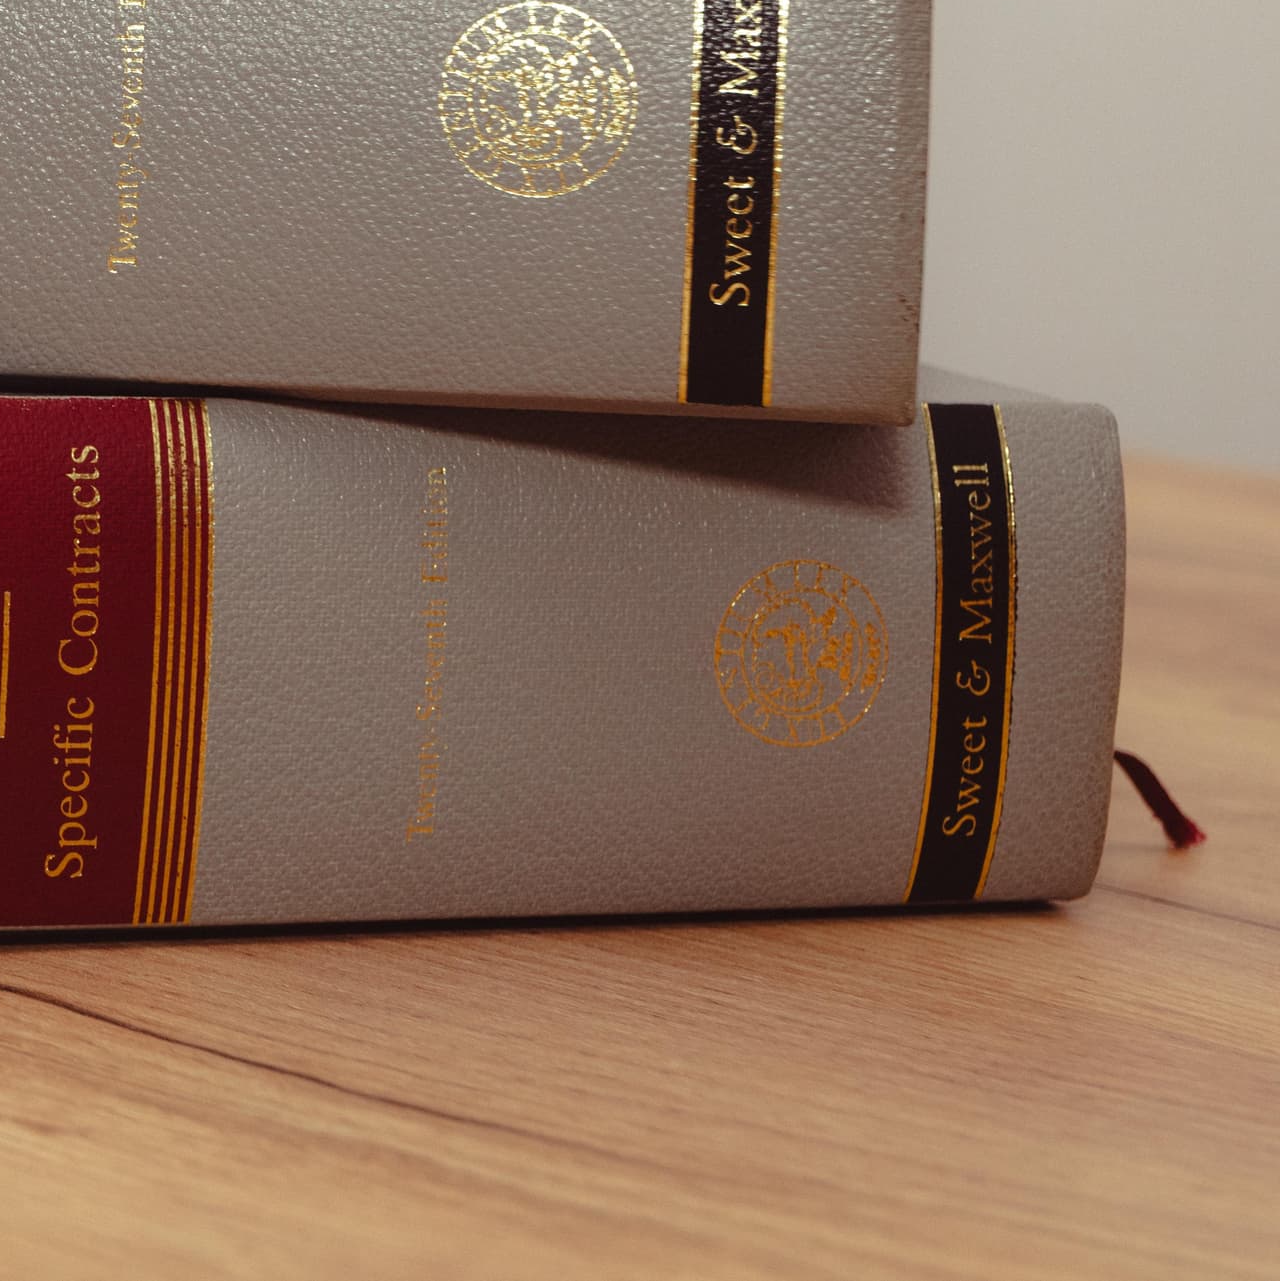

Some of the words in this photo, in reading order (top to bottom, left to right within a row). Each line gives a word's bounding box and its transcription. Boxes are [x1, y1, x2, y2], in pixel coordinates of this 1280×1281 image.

[108, 20, 149, 274] Twenty-Seventh
[716, 115, 759, 156] &
[709, 176, 757, 308] Sweet
[57, 444, 101, 676] Contracts
[952, 462, 993, 645] Maxwell
[955, 660, 992, 698] &
[44, 695, 98, 879] Specific
[942, 715, 987, 838] Sweet
